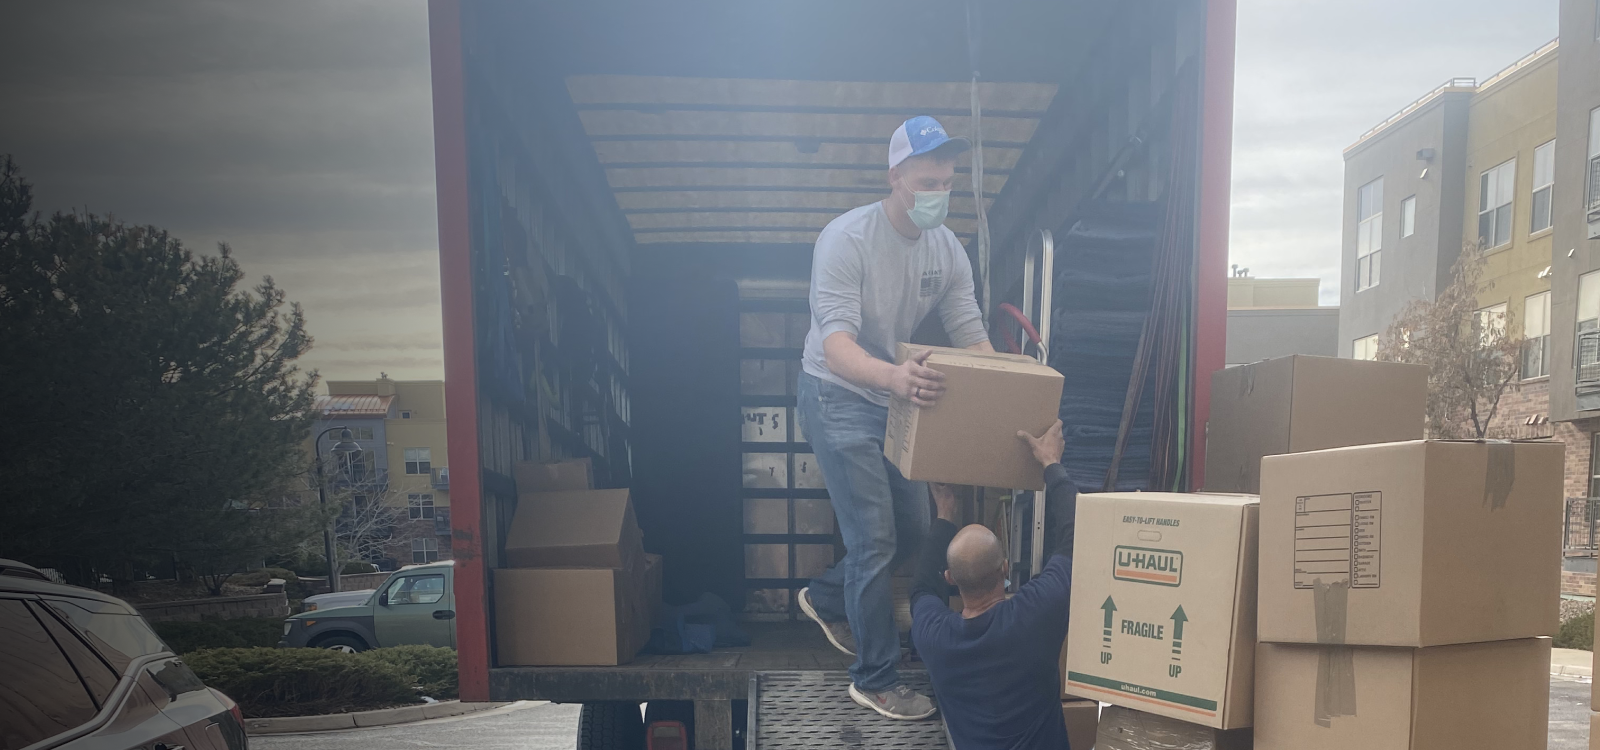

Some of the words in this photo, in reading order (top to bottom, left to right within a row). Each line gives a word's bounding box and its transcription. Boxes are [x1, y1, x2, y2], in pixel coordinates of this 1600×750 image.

[1122, 515, 1156, 526] EASY-TO-LIFT
[1156, 516, 1180, 527] HANDLES
[1118, 551, 1178, 573] U-HAUL
[1121, 619, 1164, 640] FRAGILE
[1100, 651, 1113, 665] UP
[1169, 664, 1182, 678] UP
[1120, 683, 1157, 697] uhaul.com
